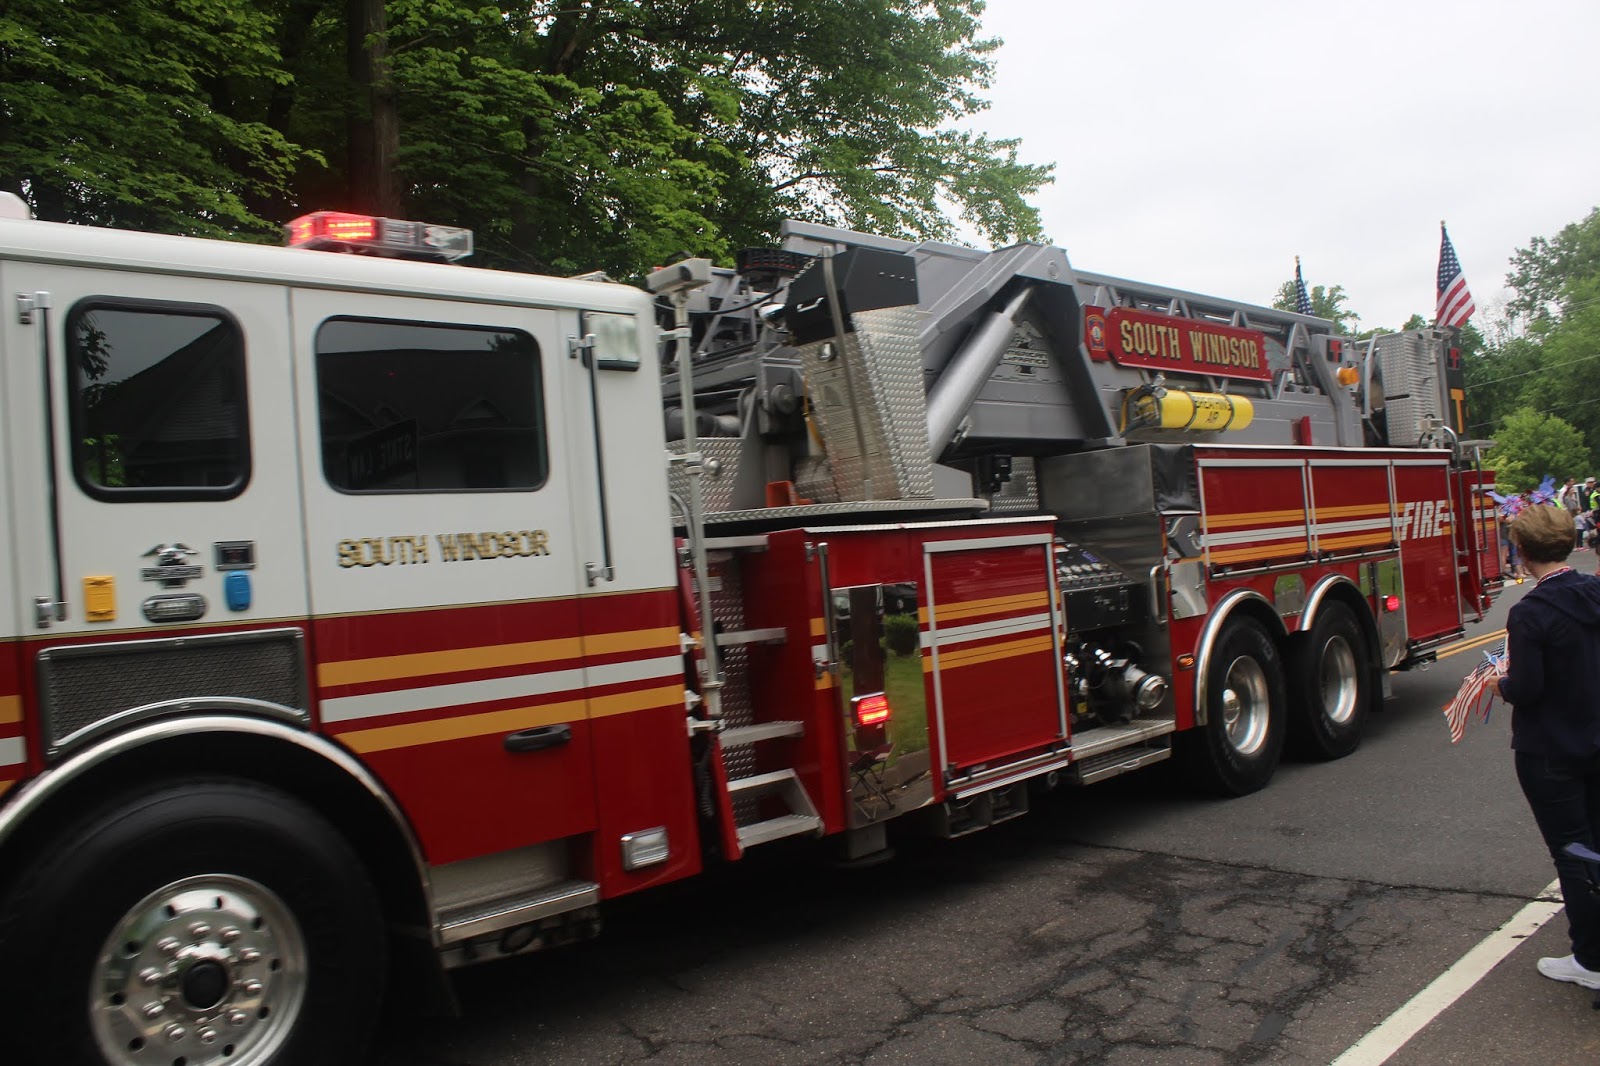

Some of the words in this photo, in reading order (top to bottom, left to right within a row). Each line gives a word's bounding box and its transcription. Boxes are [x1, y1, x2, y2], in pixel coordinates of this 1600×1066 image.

[1120, 320, 1181, 359] SOUTH
[1189, 330, 1259, 368] WINDSOR
[1400, 500, 1446, 541] FIRE
[336, 534, 429, 568] SOUTH
[436, 529, 551, 563] WINDSOR
